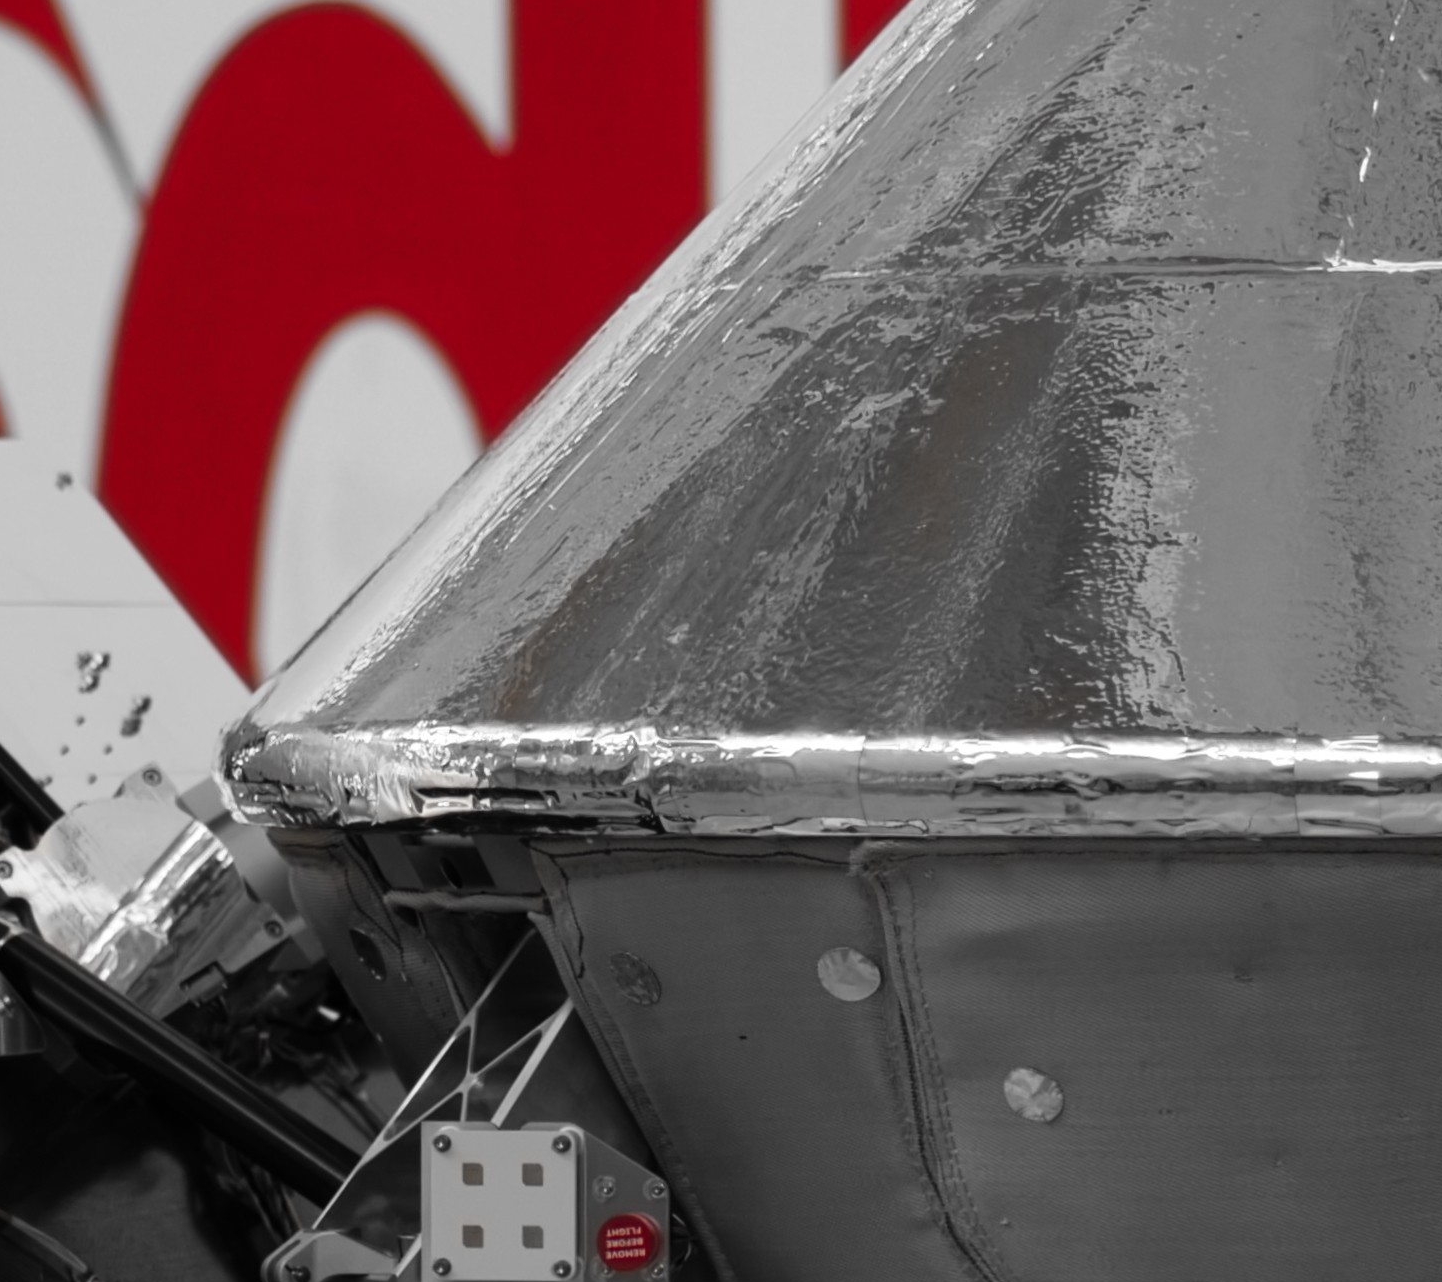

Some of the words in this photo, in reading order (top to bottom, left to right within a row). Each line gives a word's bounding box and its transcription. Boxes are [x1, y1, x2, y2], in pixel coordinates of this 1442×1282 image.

[605, 1226, 642, 1238] FLIGHT
[605, 1237, 644, 1249] BEFORE
[605, 1248, 646, 1260] REMOVE
